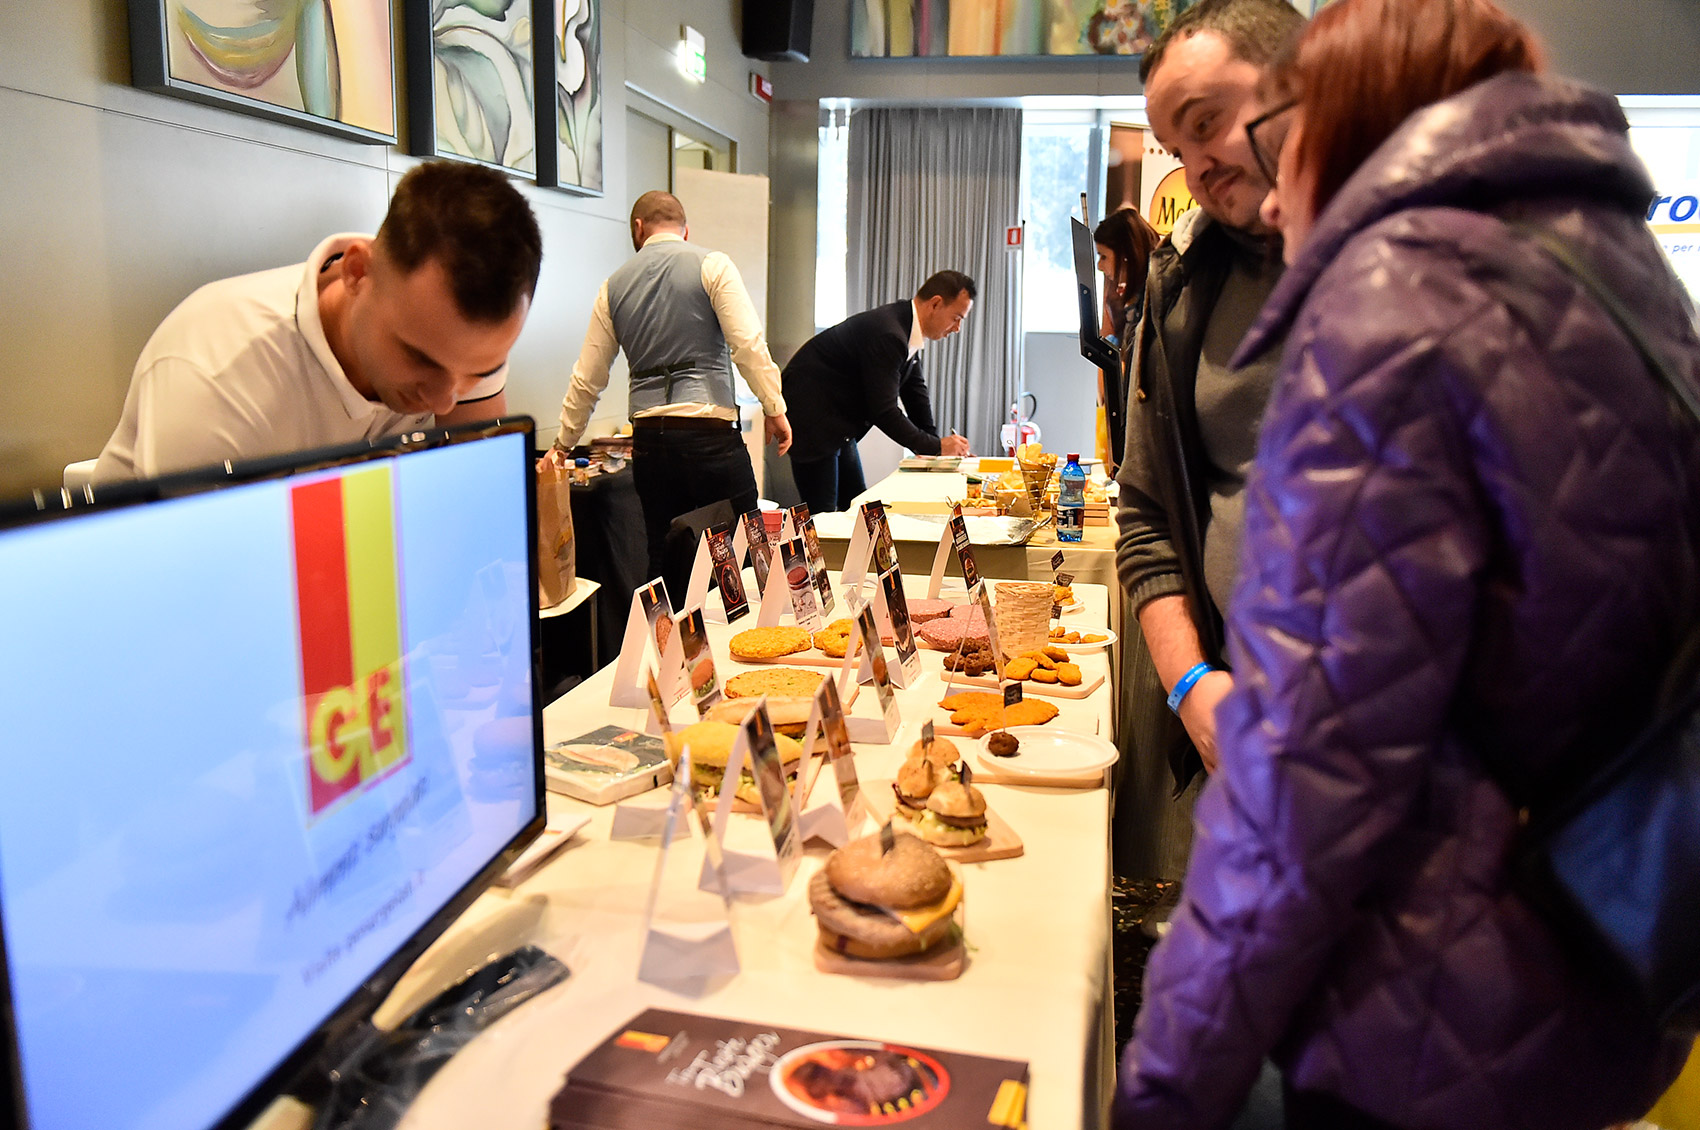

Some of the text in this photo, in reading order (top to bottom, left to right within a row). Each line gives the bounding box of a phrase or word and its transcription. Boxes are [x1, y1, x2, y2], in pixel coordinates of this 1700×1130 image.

[1646, 195, 1700, 222] ro
[1672, 244, 1694, 254] per
[310, 667, 394, 784] GE
